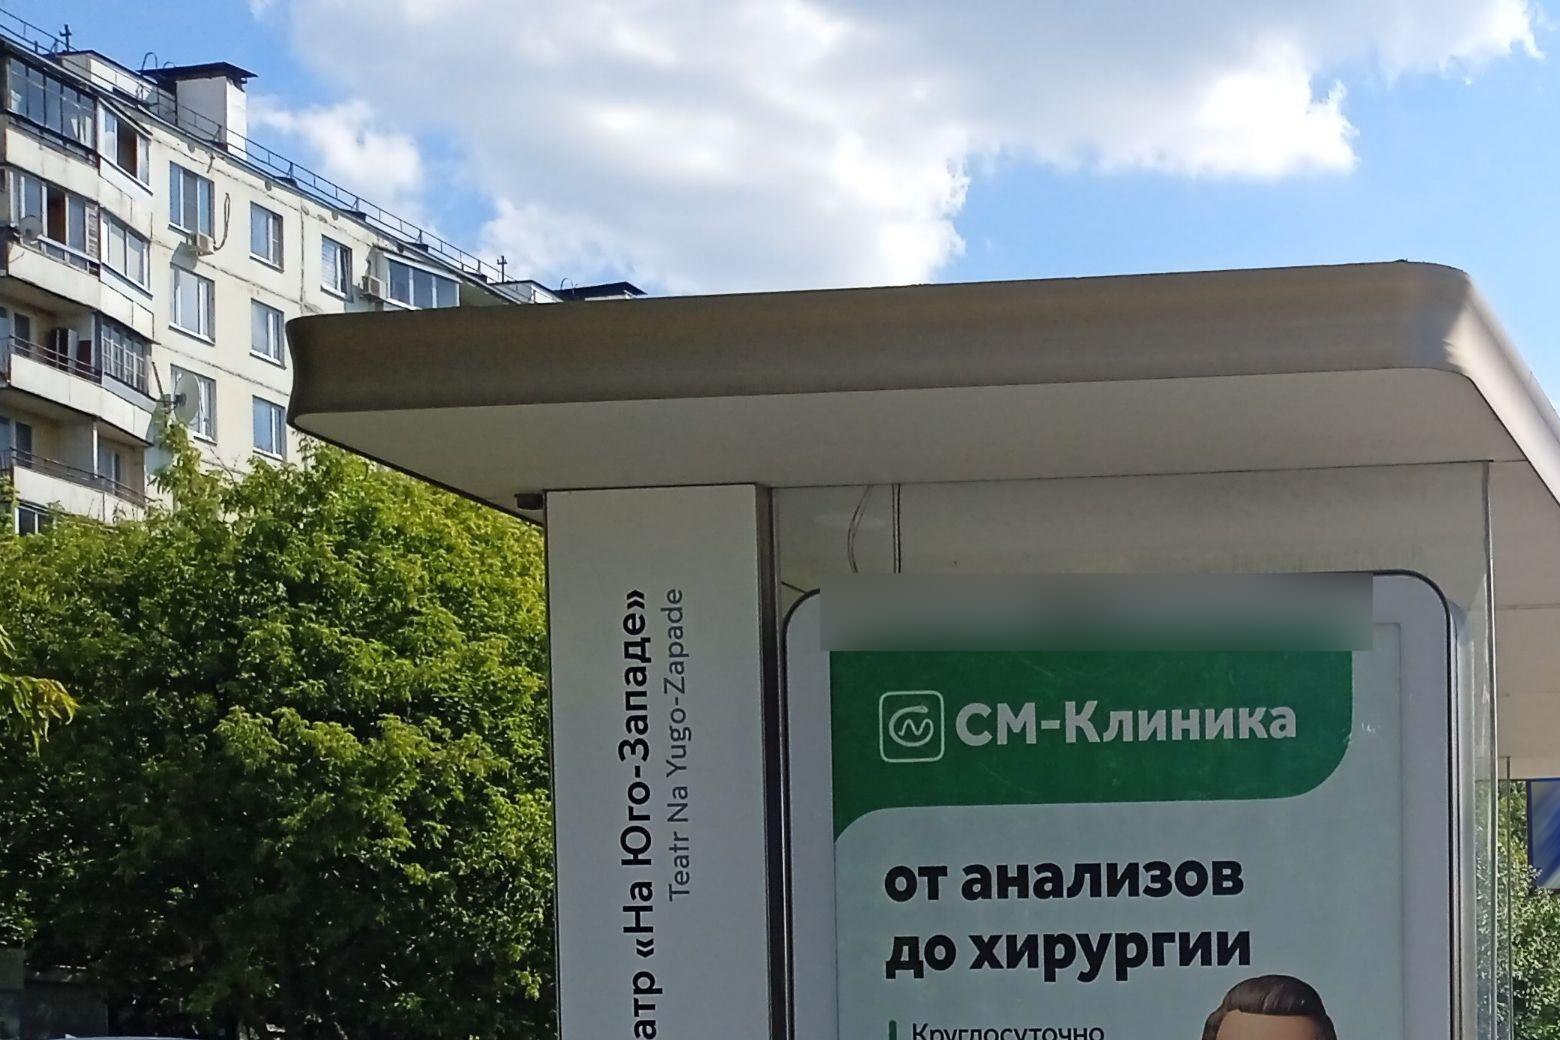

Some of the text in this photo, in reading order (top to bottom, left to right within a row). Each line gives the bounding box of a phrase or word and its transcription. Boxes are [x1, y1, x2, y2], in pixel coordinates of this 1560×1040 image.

[617, 589, 653, 866] Юго-Западе»
[660, 588, 692, 901] Teatr Na Yugo-Zapade
[955, 700, 1298, 747] СМ-Клиника
[884, 859, 1245, 902] от анализов
[622, 880, 654, 958] «На
[885, 930, 1251, 982] до хирургии
